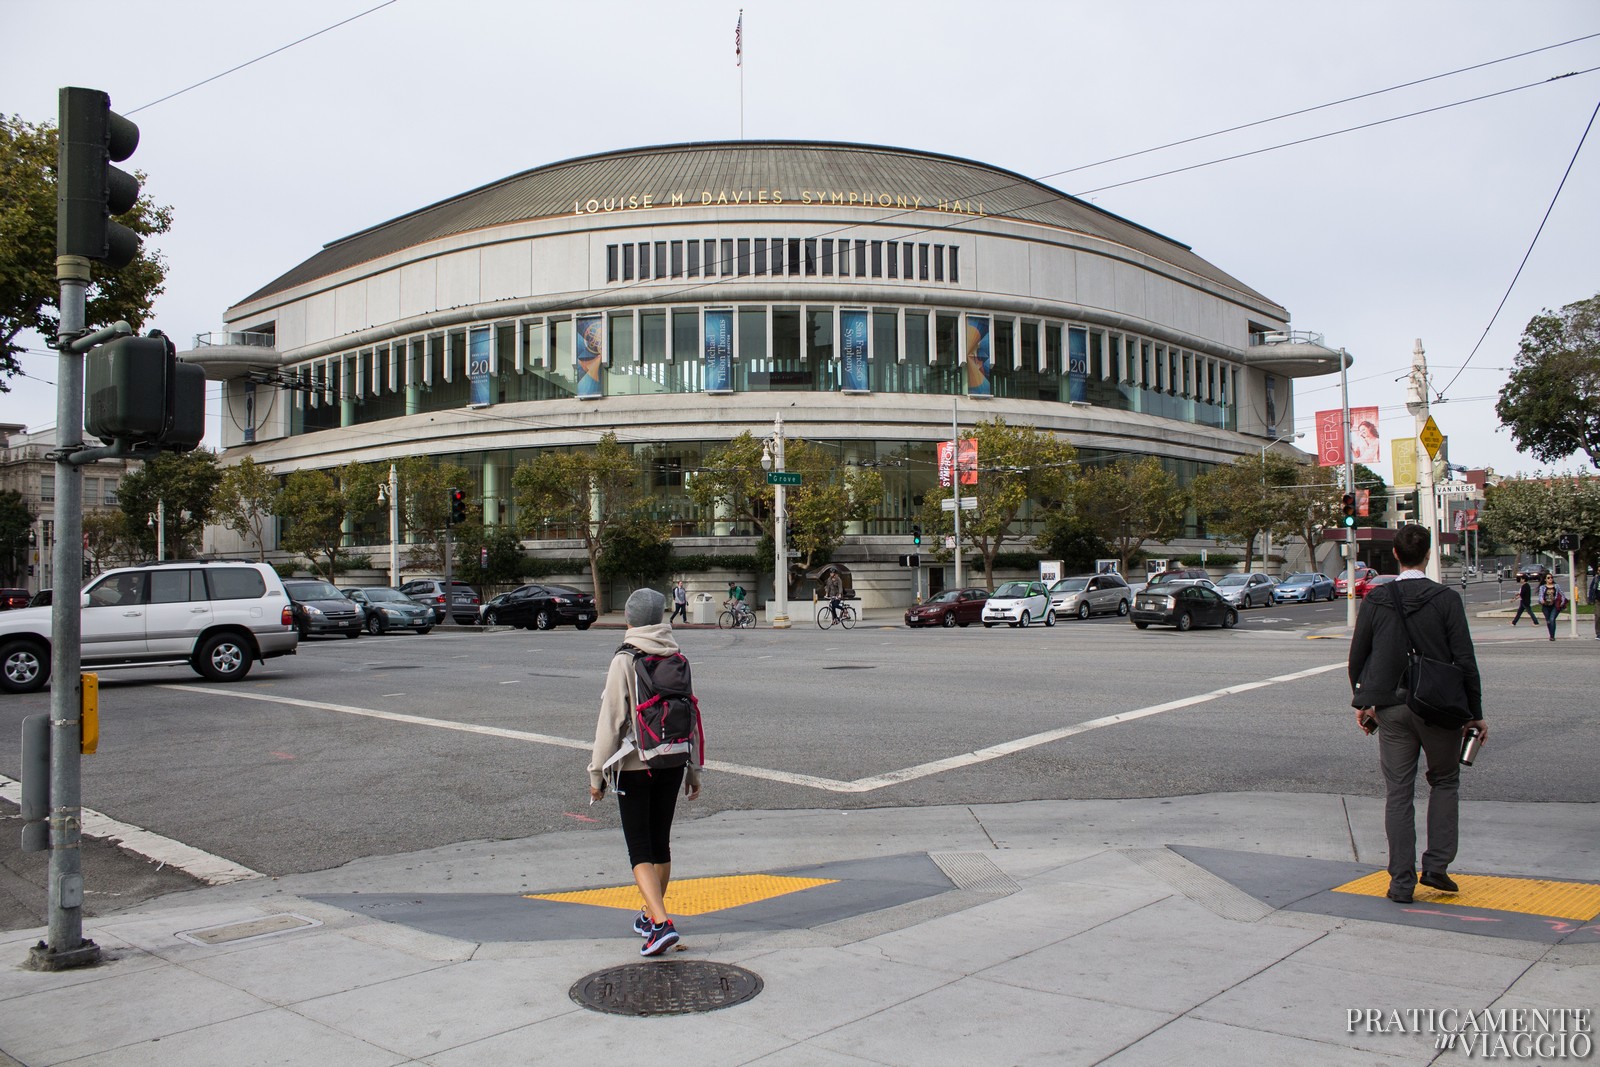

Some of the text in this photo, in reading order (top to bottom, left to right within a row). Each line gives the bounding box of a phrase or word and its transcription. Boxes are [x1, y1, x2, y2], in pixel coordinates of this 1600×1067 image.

[574, 190, 988, 216] LOUISE M DAVIES SYMPHONY HALL
[471, 359, 488, 375] 20
[707, 334, 716, 368] Michael
[717, 319, 726, 383] Tilson Thomas
[844, 328, 855, 374] Symphony
[855, 321, 865, 381] San Francisco
[1070, 358, 1086, 374] 20
[1323, 412, 1340, 463] OPERA
[772, 475, 796, 483] Grove
[942, 441, 954, 487] SYMPHONY
[1398, 440, 1412, 484] OPERA
[1455, 484, 1474, 492] NESS
